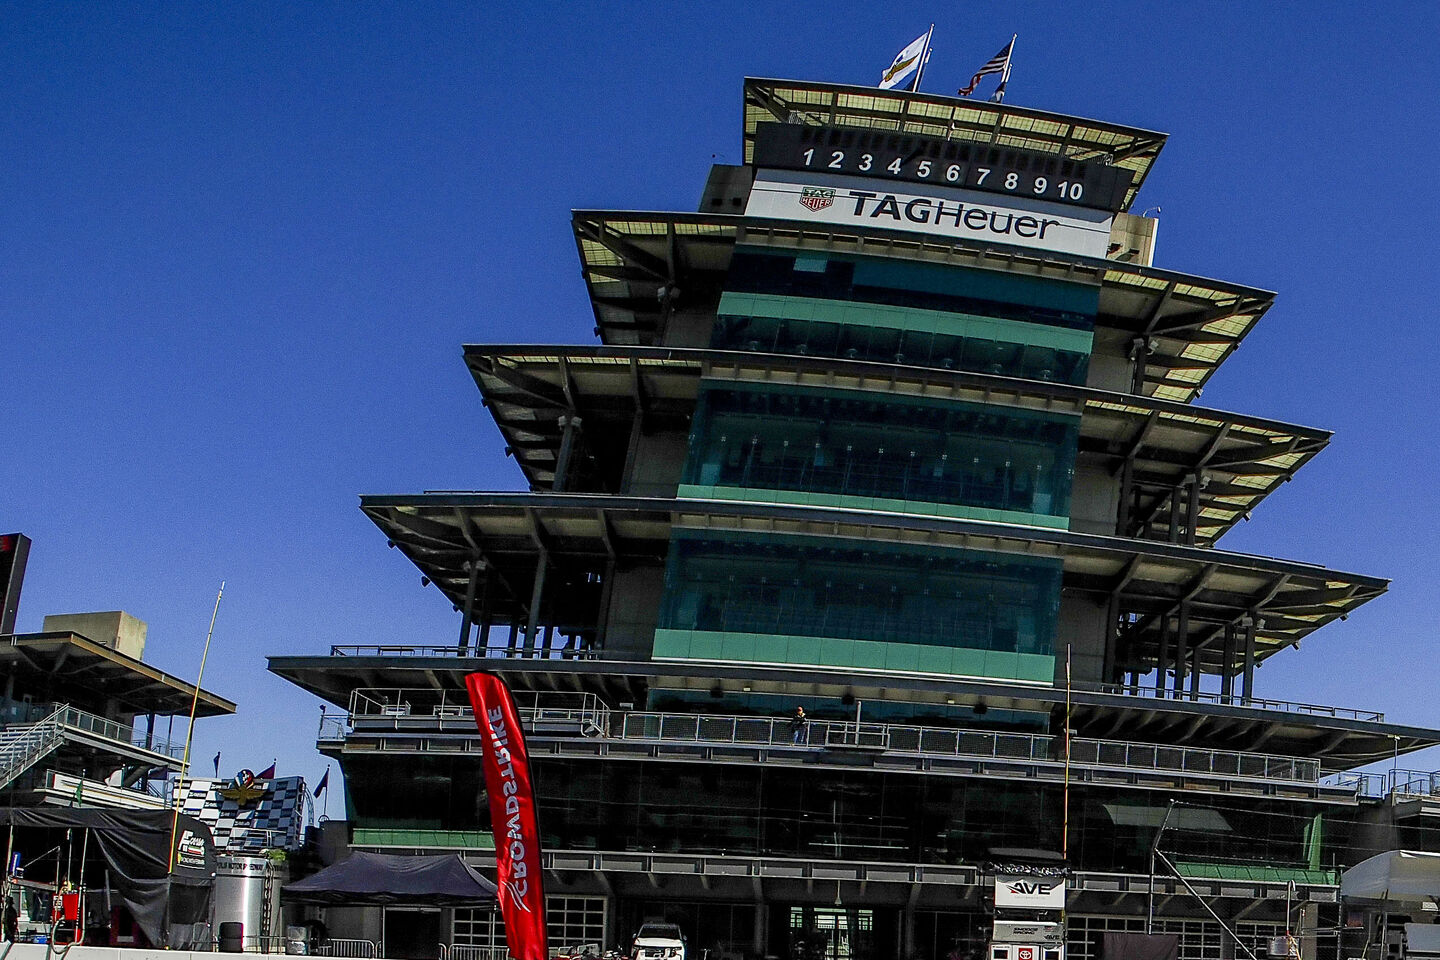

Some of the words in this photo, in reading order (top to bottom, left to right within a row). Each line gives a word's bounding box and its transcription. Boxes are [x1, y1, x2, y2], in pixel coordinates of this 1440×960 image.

[803, 149, 814, 166] 1
[828, 151, 844, 169] 2
[859, 154, 873, 171] 3
[887, 157, 901, 175] 4
[917, 160, 932, 178] 5
[946, 164, 961, 182] 6
[977, 168, 991, 185] 7
[1005, 172, 1018, 190] 8
[1034, 177, 1047, 194] 9
[1057, 181, 1083, 200] 10
[801, 197, 833, 208] HEUER
[1006, 883, 1051, 895] AVE
